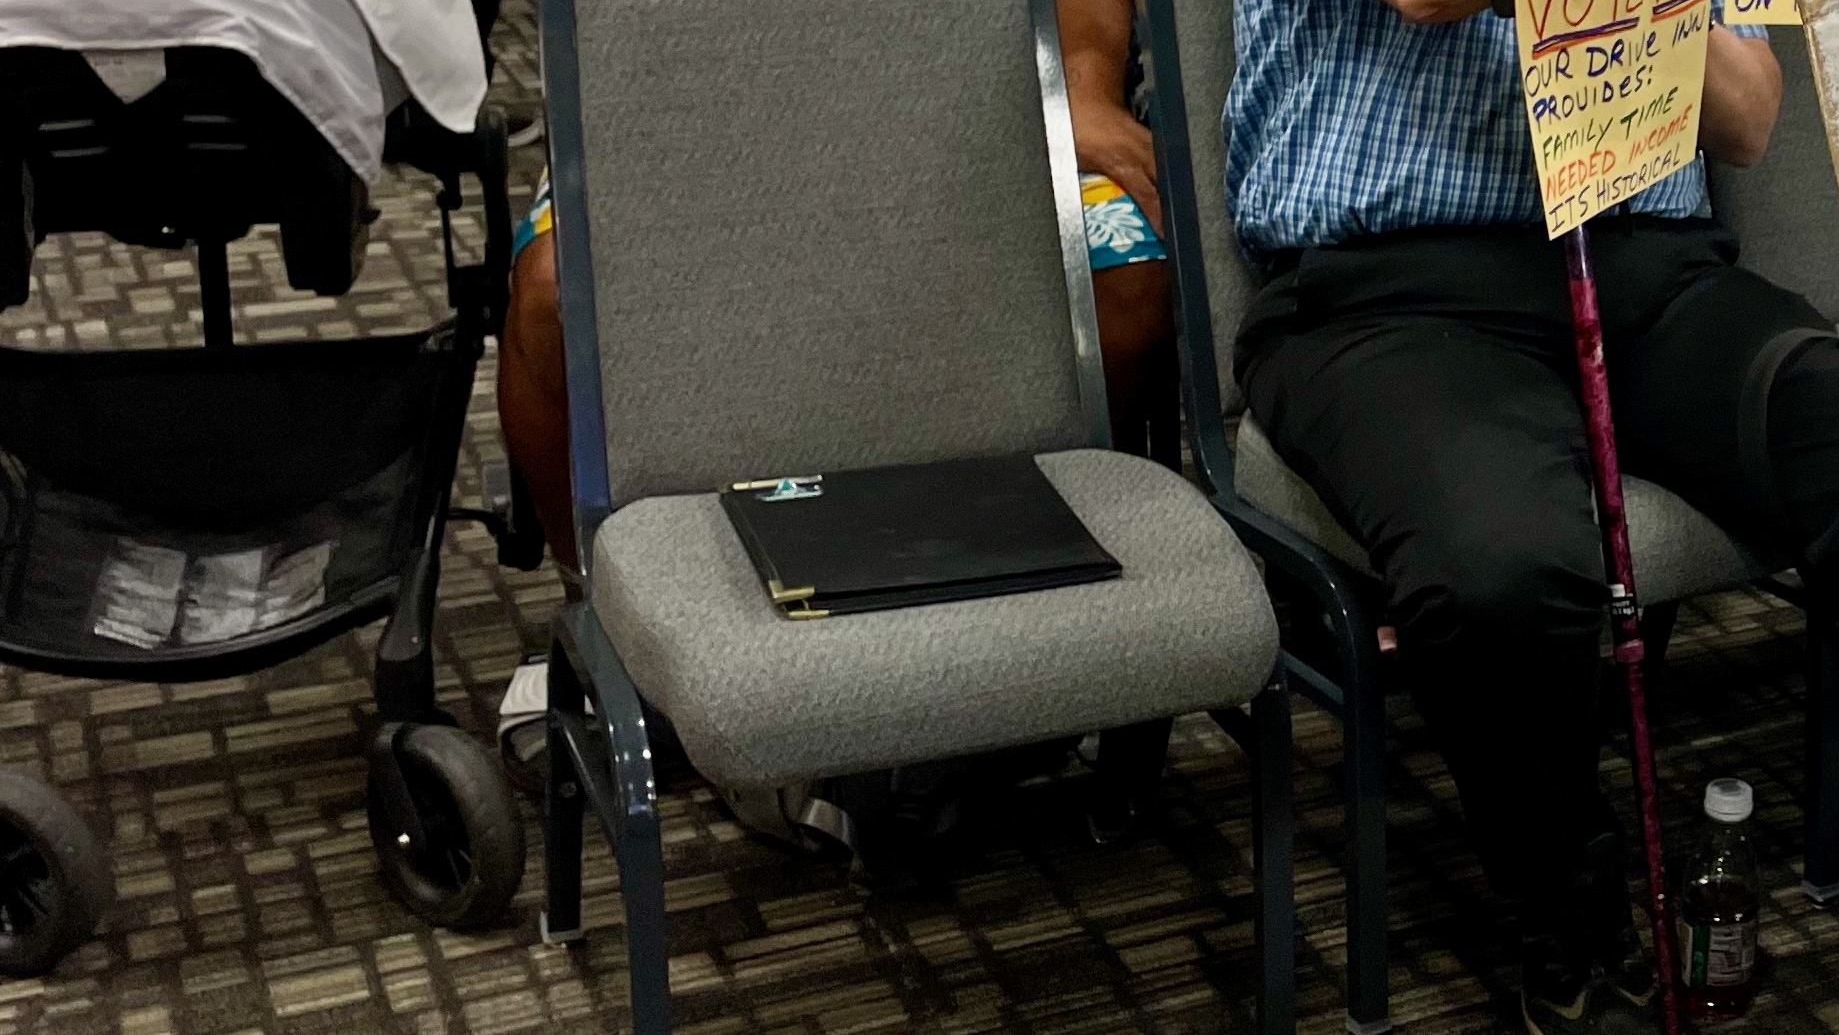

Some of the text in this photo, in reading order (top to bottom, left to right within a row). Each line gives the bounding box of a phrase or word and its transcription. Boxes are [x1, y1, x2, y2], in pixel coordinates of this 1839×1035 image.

[1524, 46, 1573, 98] OUR
[1672, 11, 1707, 48] INN
[1542, 86, 1680, 172] FAMILY TIME
[1545, 102, 1694, 202] NEEDED INCOME
[1548, 142, 1682, 234] ITS HISTORICAL
